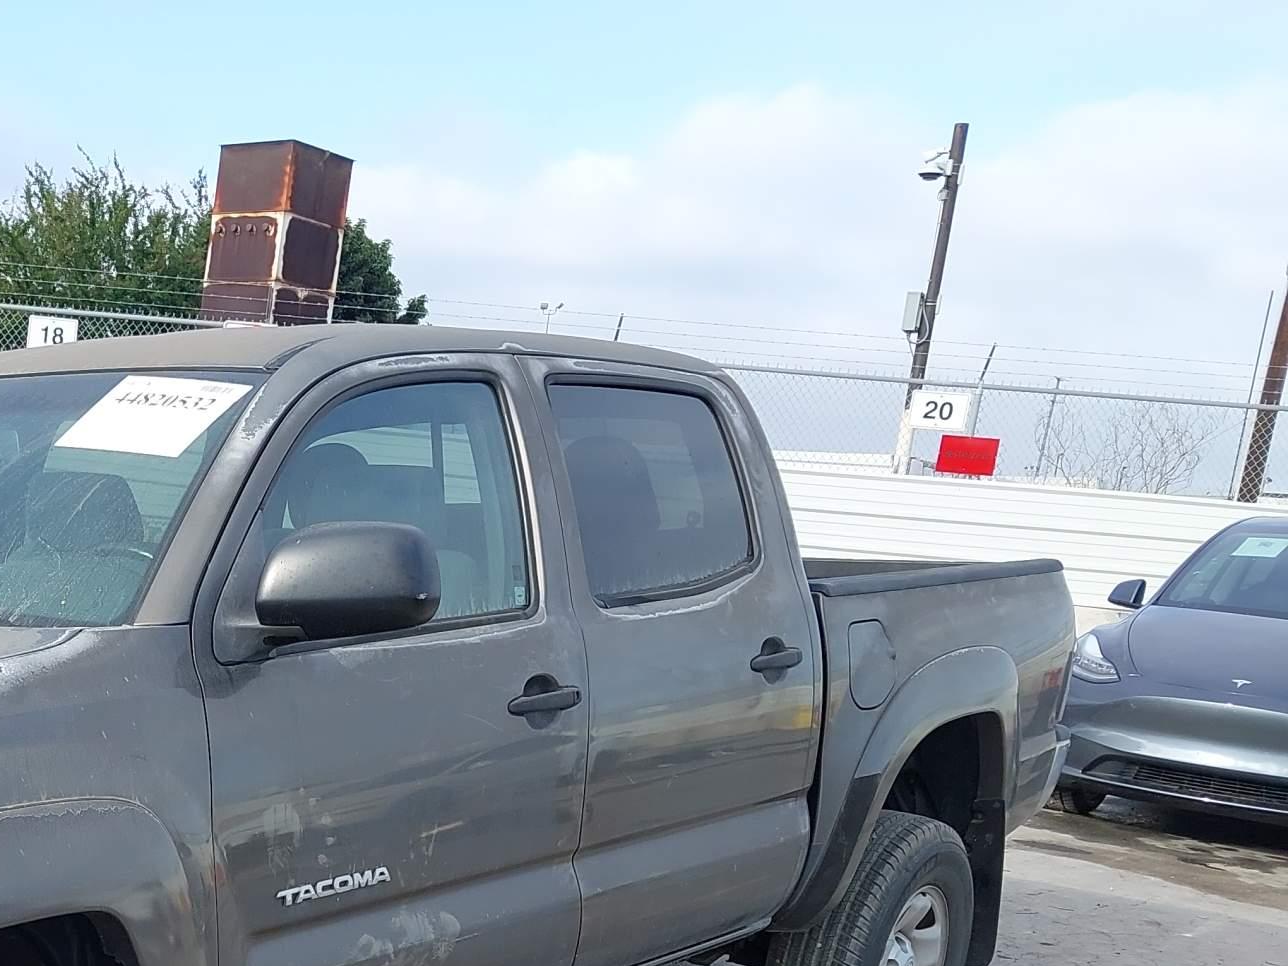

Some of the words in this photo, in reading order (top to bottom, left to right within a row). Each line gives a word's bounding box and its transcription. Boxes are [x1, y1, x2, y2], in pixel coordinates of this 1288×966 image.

[41, 326, 64, 344] 18
[115, 392, 217, 410] 44820532
[922, 400, 954, 421] 20
[275, 865, 392, 907] TACOMA
